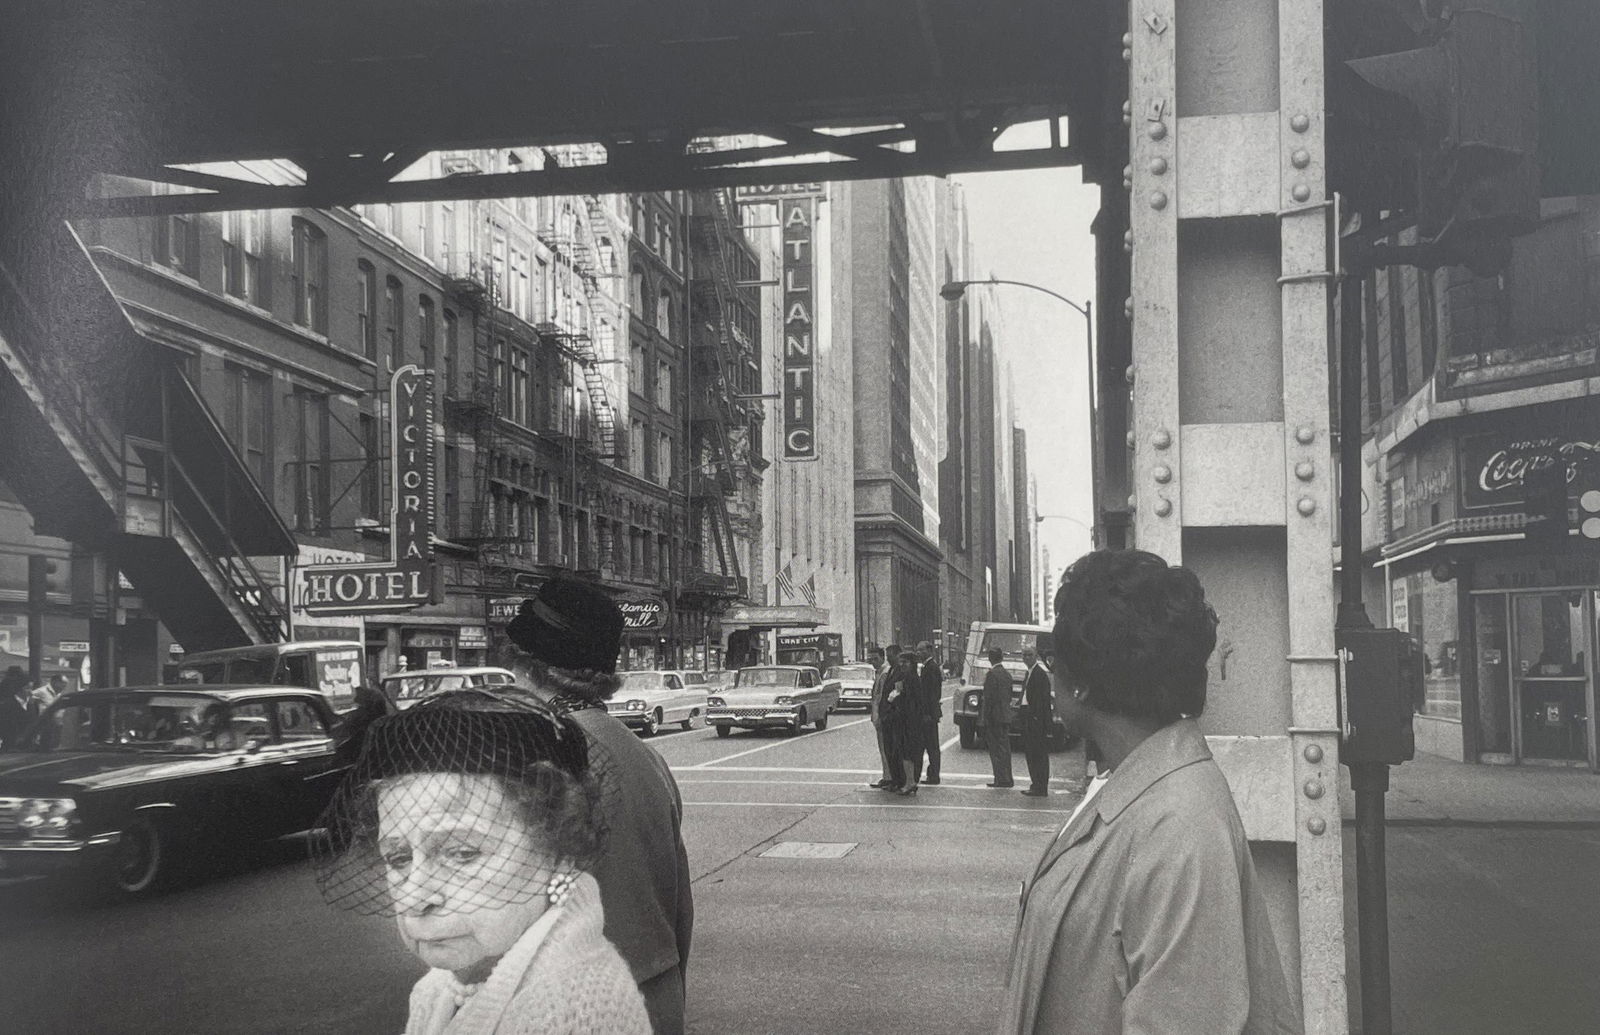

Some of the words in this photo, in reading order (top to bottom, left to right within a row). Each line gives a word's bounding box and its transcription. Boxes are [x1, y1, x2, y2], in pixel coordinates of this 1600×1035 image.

[786, 206, 810, 452] ATLANTIC
[401, 379, 422, 560] VICTORIA
[310, 571, 429, 603] HOTEL
[489, 604, 521, 616] JEWE
[622, 612, 655, 627] rill
